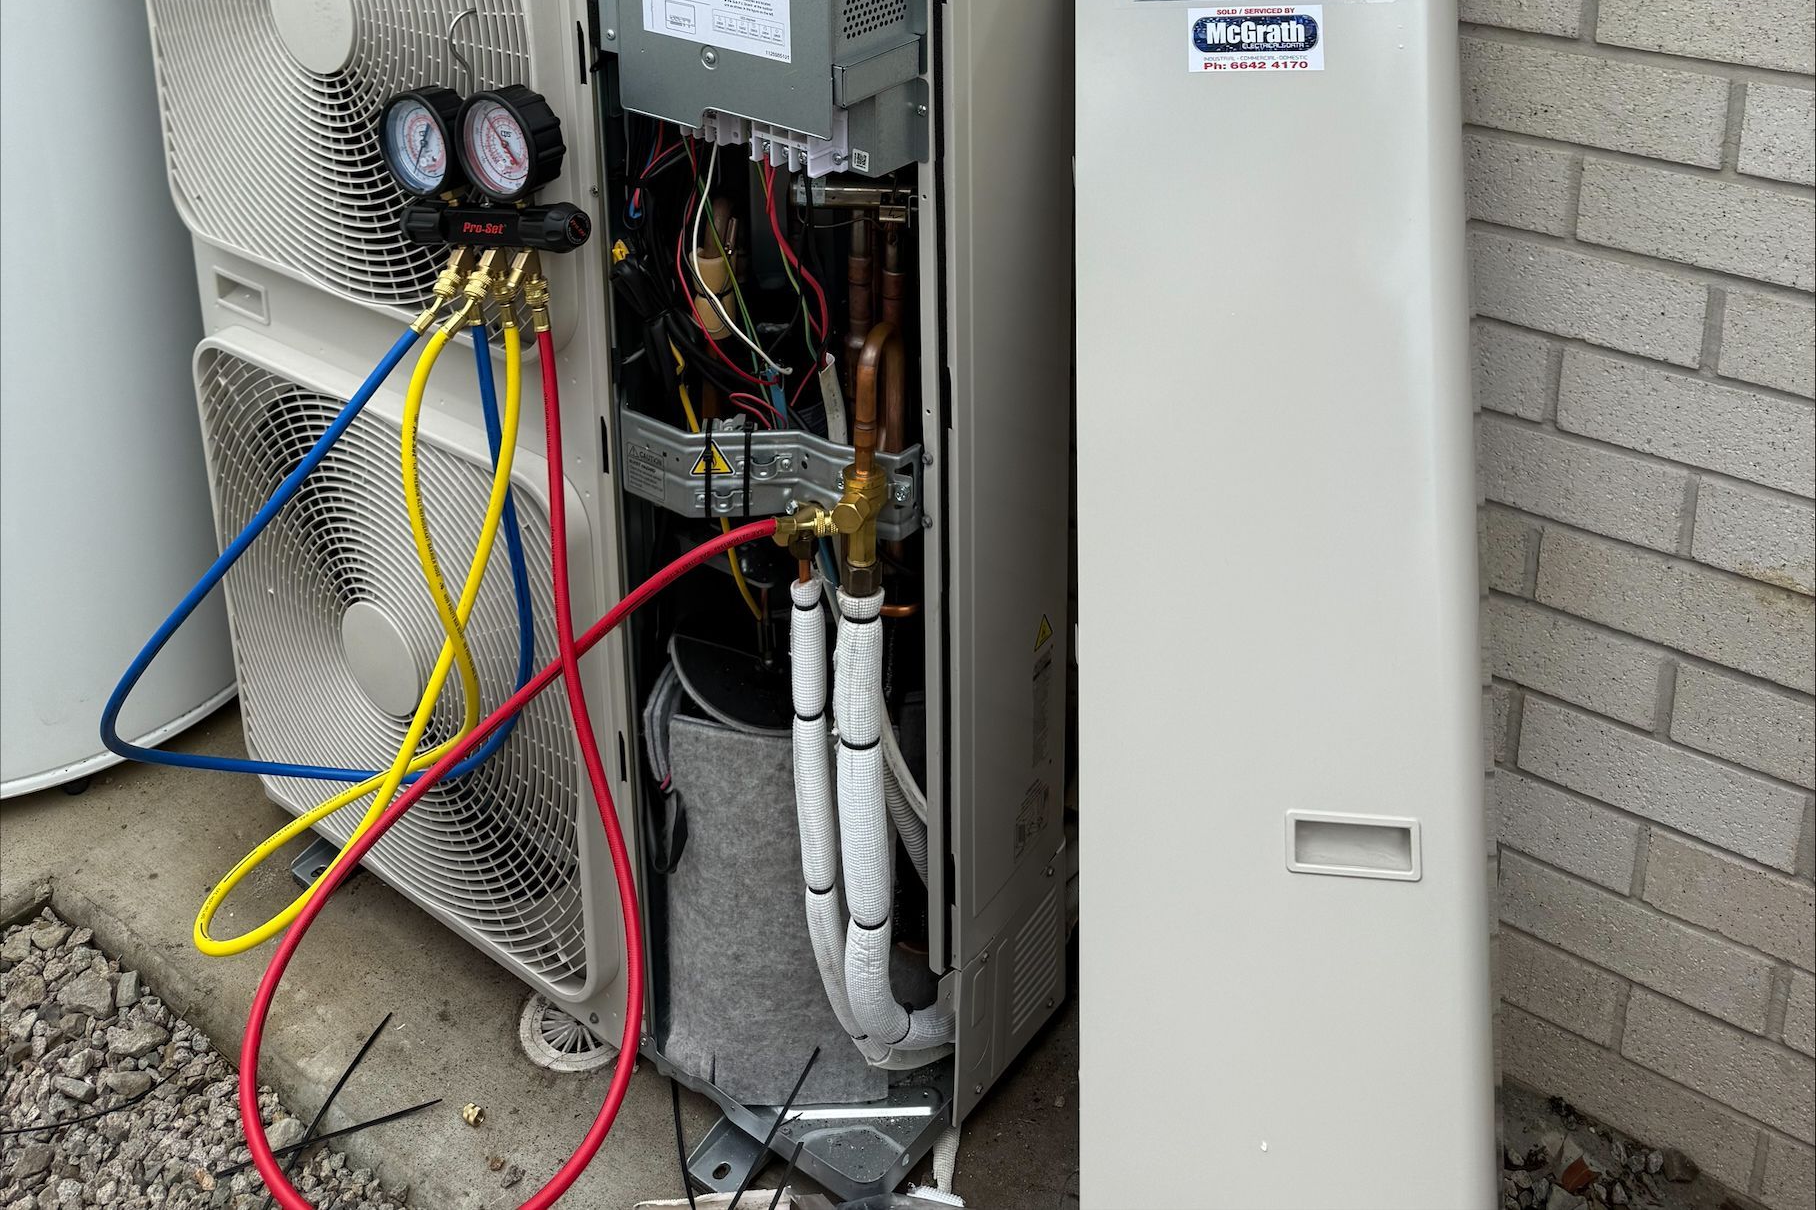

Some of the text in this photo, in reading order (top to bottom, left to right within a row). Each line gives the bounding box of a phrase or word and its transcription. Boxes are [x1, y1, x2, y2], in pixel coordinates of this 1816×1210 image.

[1206, 21, 1305, 44] McGrath
[463, 221, 504, 235] Pro-Set
[639, 451, 662, 466] CAUTION
